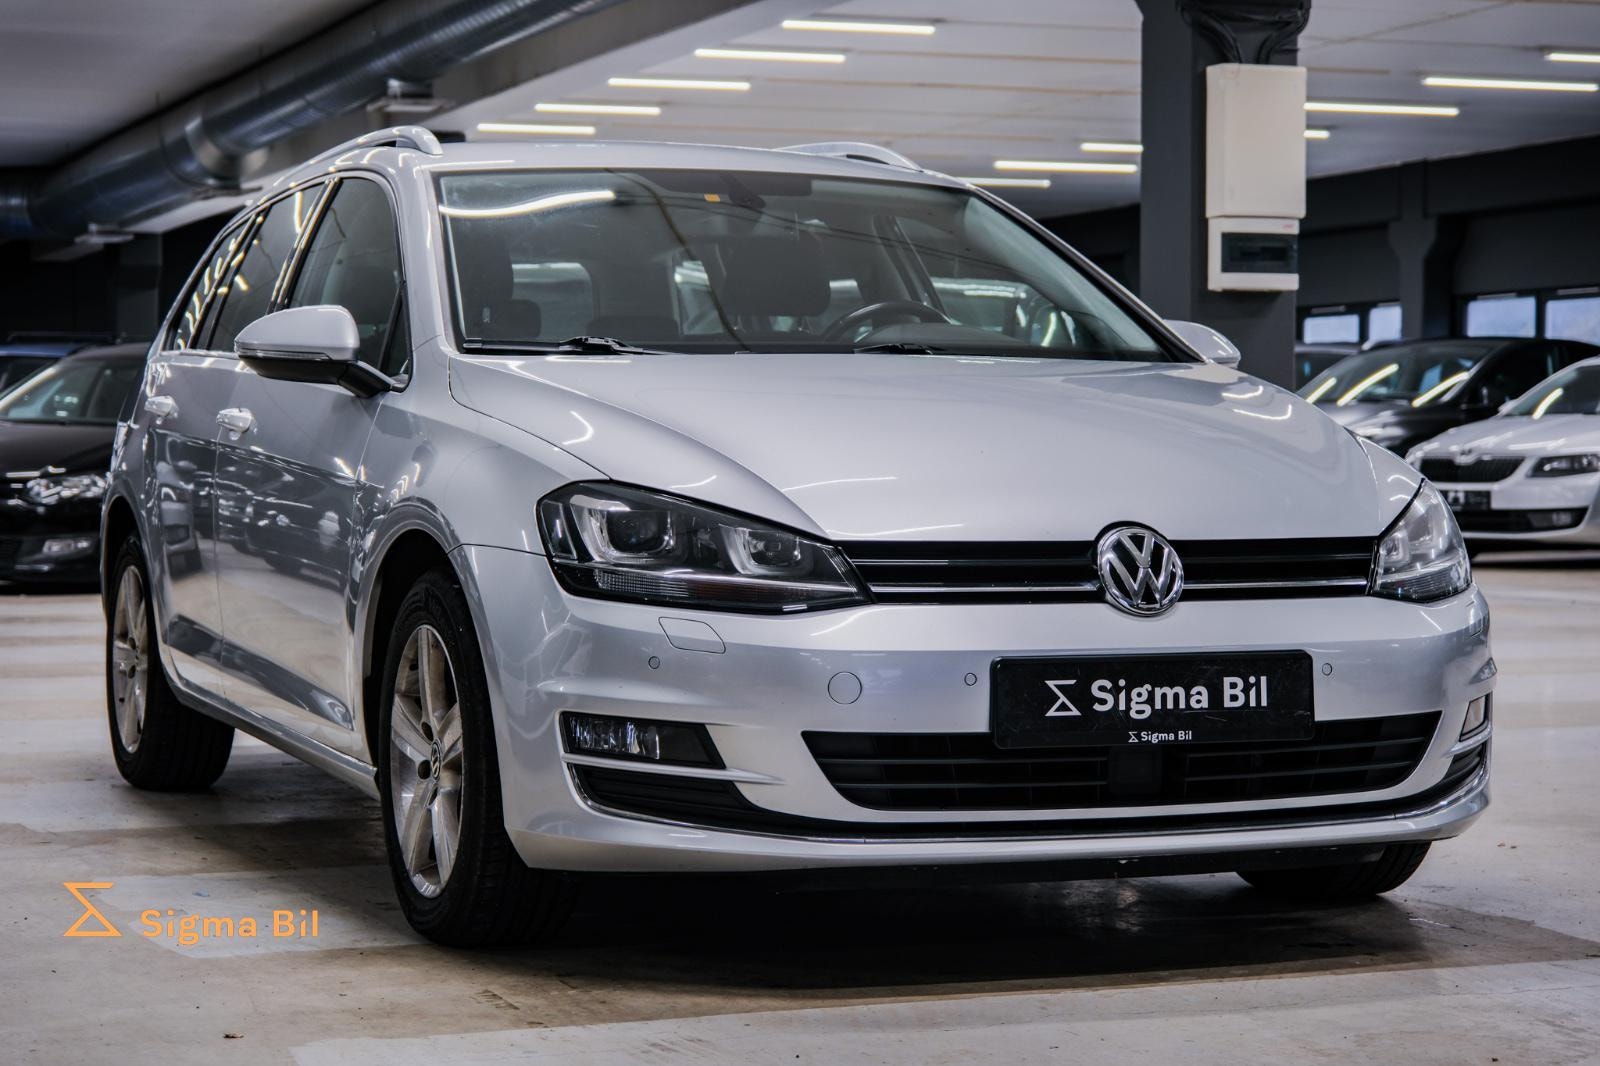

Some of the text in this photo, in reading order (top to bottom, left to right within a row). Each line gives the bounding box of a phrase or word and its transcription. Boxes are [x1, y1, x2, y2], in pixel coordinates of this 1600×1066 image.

[1090, 675, 1268, 720] Sigma Bil
[1140, 730, 1192, 743] Sigma Bil
